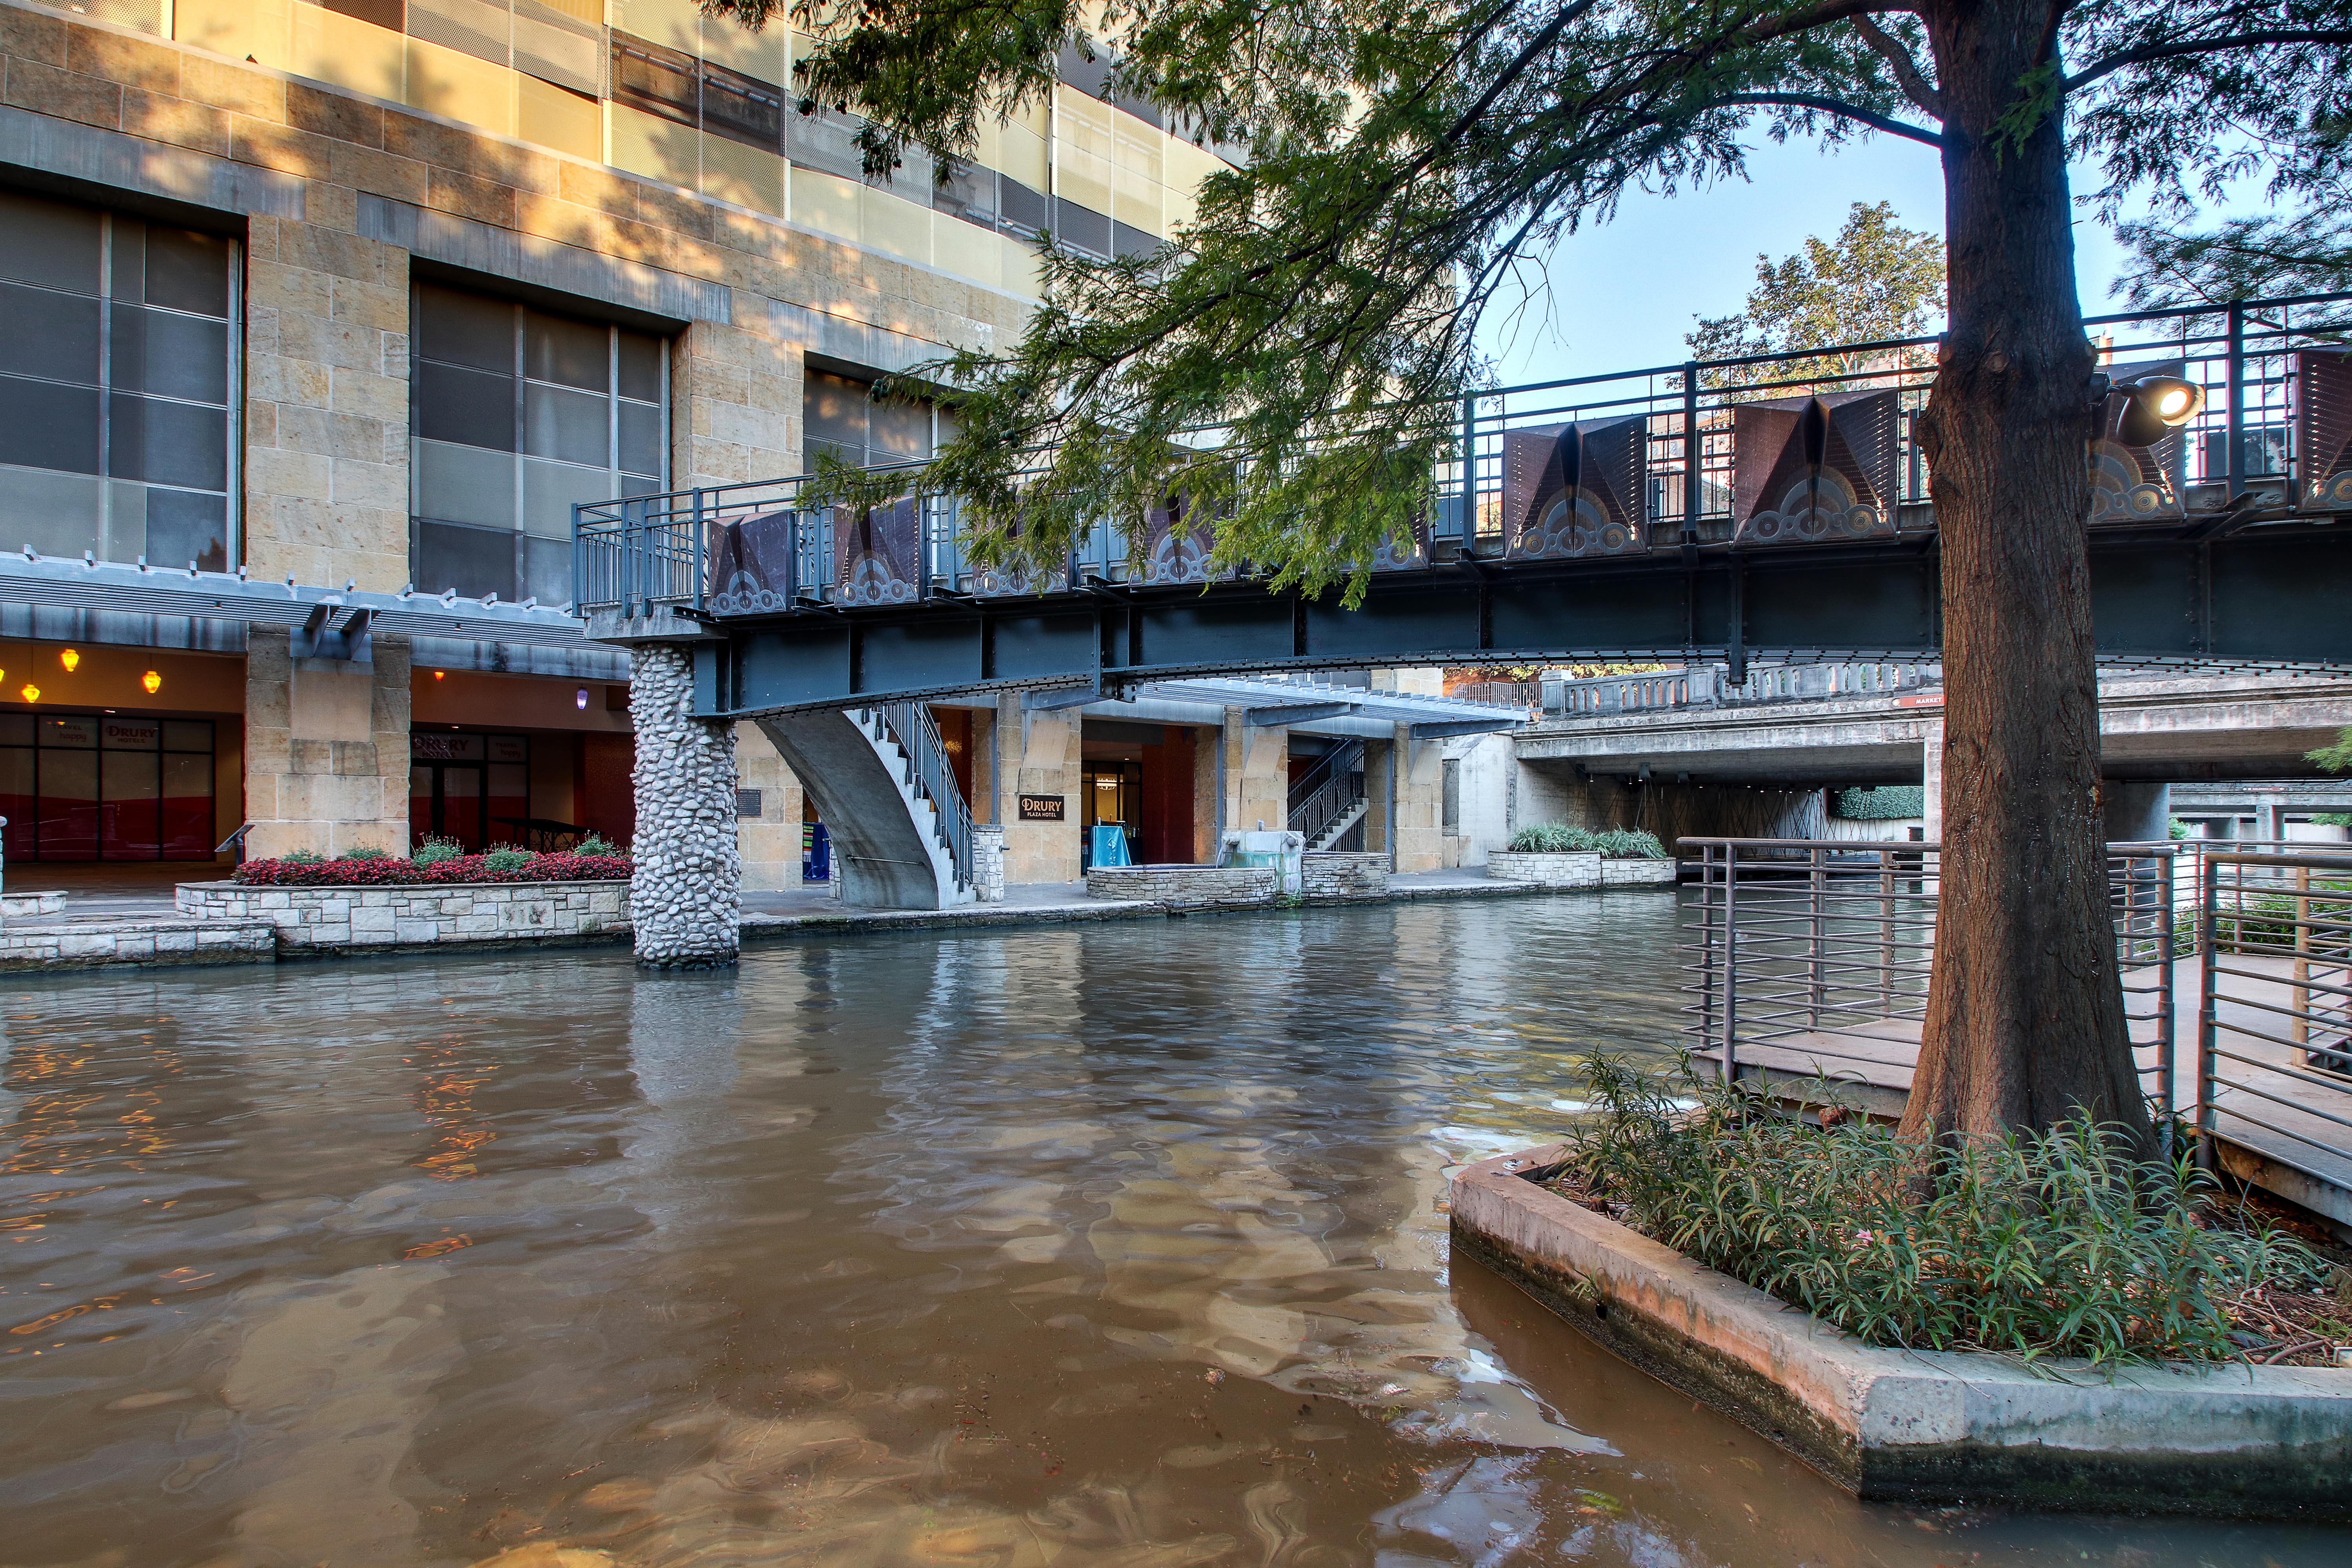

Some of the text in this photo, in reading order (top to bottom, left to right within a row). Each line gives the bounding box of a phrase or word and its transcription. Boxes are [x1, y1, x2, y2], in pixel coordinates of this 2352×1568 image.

[60, 731, 87, 742] happy
[106, 726, 157, 738] DRURY
[412, 735, 469, 751] DRURY
[501, 749, 521, 757] happy
[1022, 798, 1062, 811] DRURY
